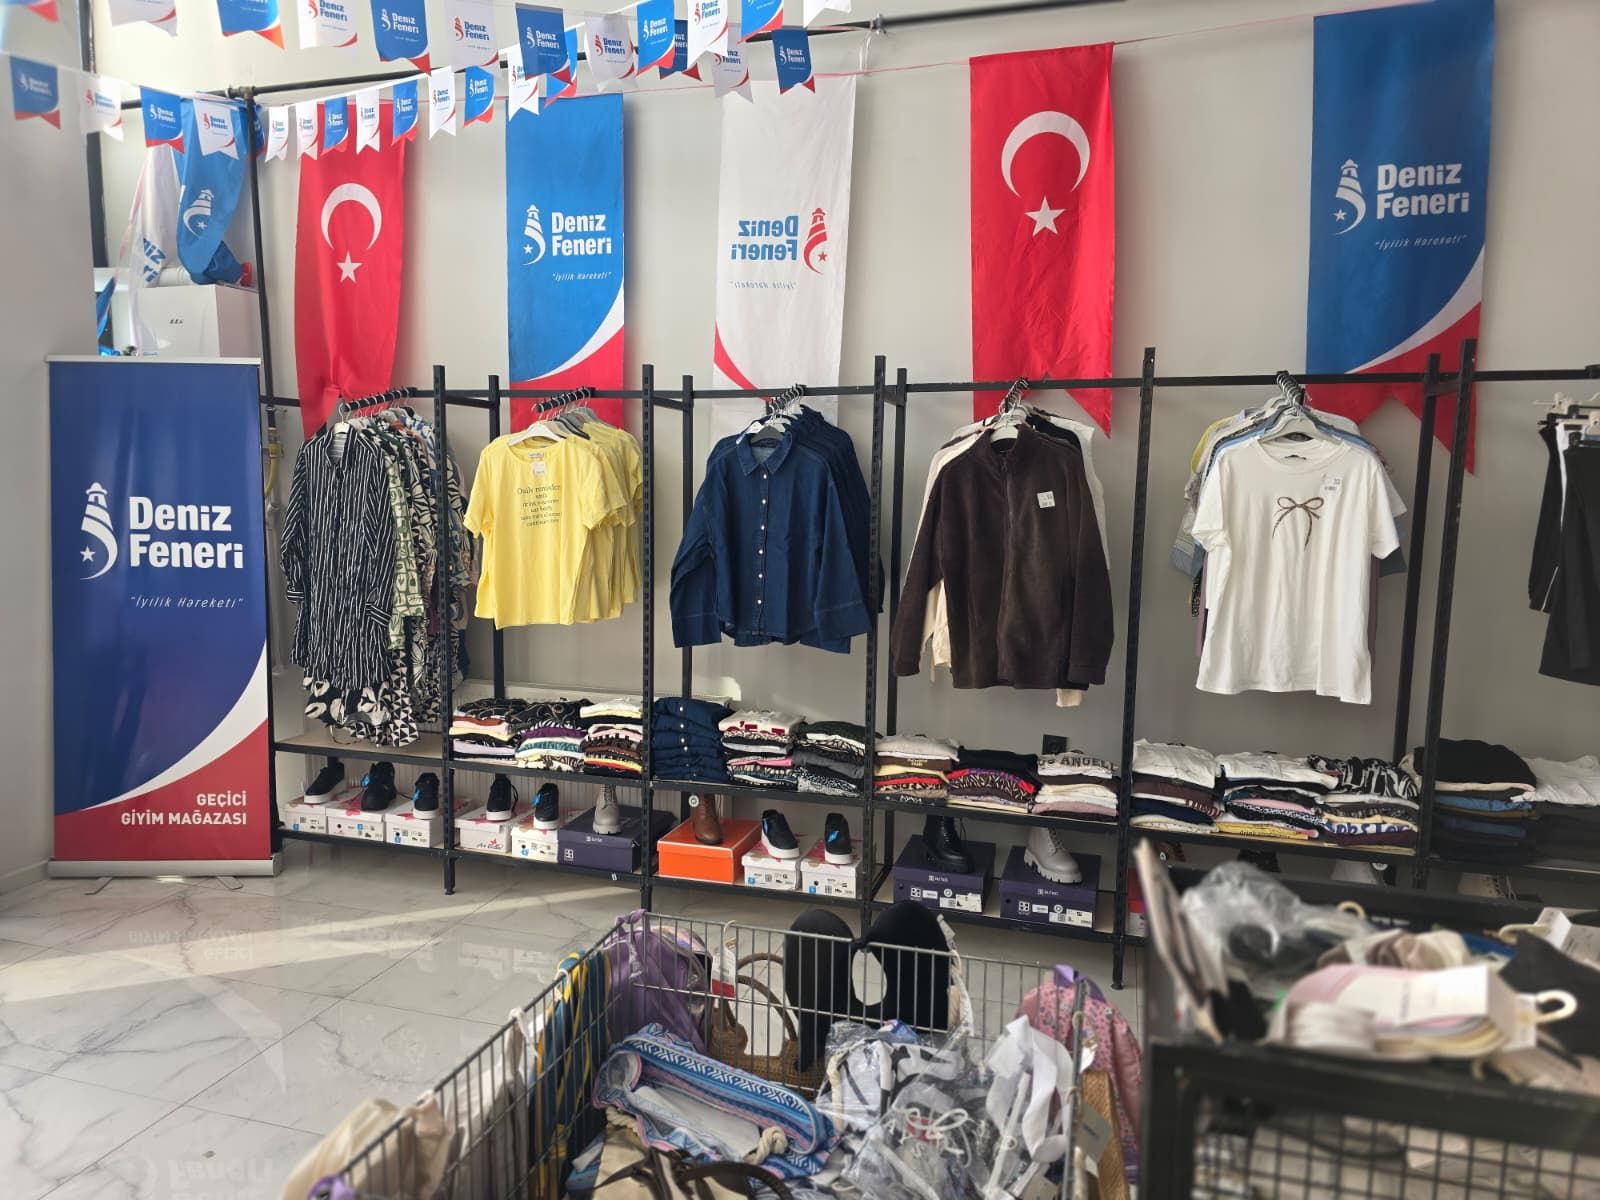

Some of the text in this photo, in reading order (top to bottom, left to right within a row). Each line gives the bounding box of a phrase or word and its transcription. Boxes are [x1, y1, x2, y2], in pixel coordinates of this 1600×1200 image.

[701, 0, 719, 11] Deniz
[392, 12, 416, 25] Deniz
[701, 8, 721, 19] Feneri
[393, 21, 419, 34] Feneri
[464, 21, 486, 32] Deniz
[649, 17, 667, 28] Deniz
[465, 30, 490, 40] Feneri
[535, 30, 556, 40] Deniz
[649, 25, 668, 37] Feneri
[536, 39, 560, 49] Feneri
[603, 37, 622, 46] Deniz
[604, 45, 626, 55] Feneri
[786, 47, 802, 56] Deniz
[787, 55, 806, 63] Feneri
[1377, 163, 1463, 192] Deniz
[1376, 191, 1470, 220] Feneri
[551, 211, 607, 234] Deniz
[552, 234, 613, 257] Feneri
[128, 496, 232, 532] Deniz
[129, 533, 244, 569] Feneri
[196, 790, 247, 808] GEÇİCİ
[121, 809, 247, 825] GİYİM MAĞAZASI
